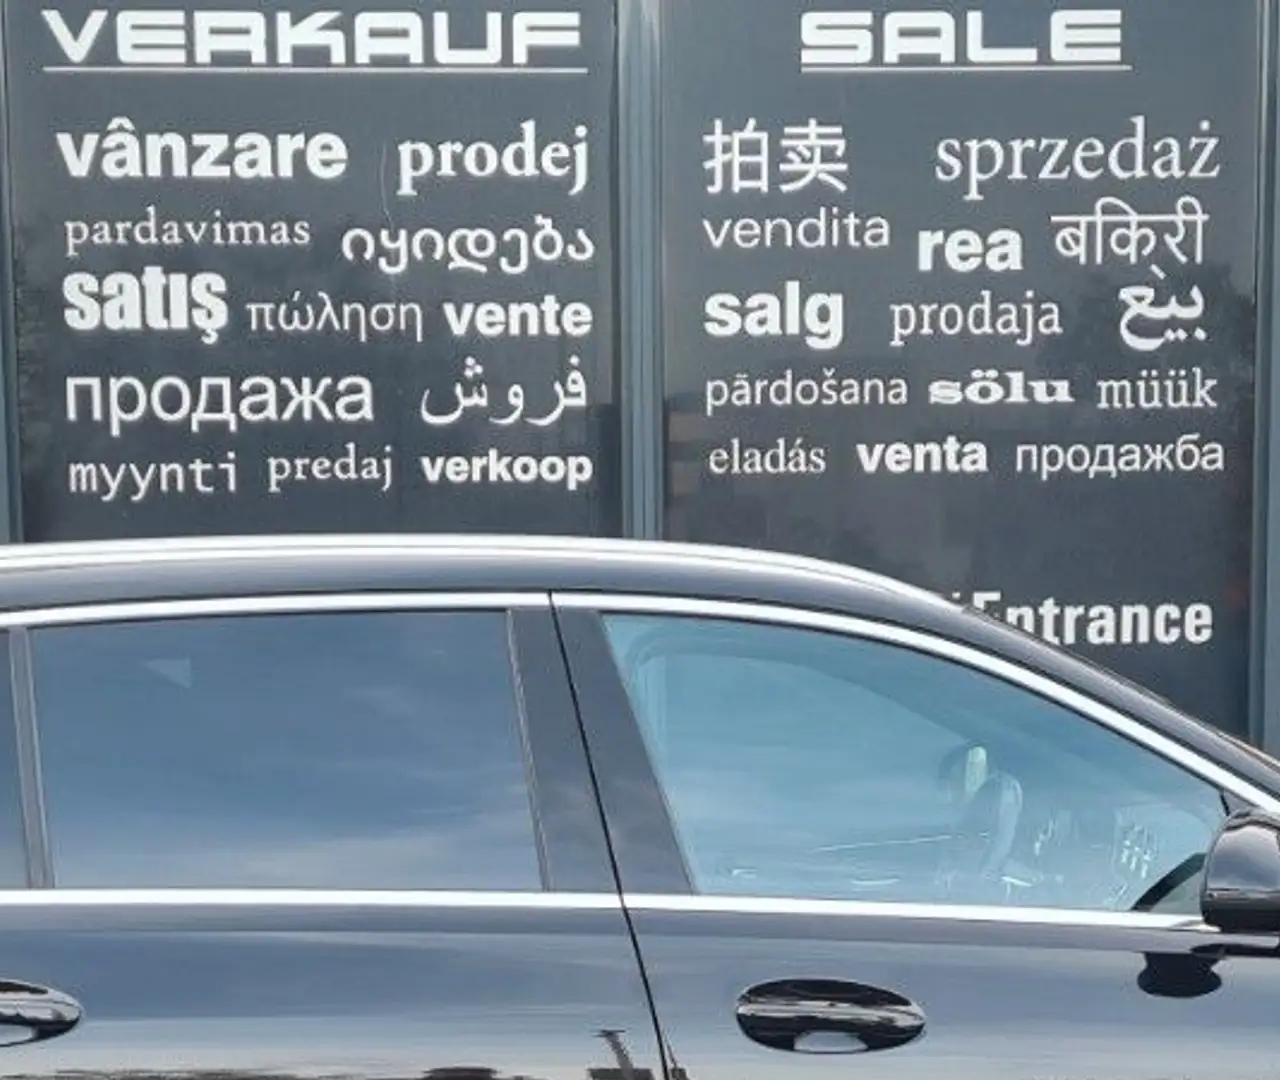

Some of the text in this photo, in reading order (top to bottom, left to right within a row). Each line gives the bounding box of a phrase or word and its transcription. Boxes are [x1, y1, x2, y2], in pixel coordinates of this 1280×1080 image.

[42, 10, 580, 64] VERKAUF
[801, 10, 1121, 64] SALE
[56, 117, 588, 196] vânzare prodej
[703, 118, 848, 194] 拍卖
[935, 115, 1220, 201] sprzedaż
[65, 205, 310, 257] pardavimas
[342, 214, 595, 275] იყიდება
[703, 206, 1022, 272] vendita rea
[63, 266, 228, 344] satış
[245, 290, 423, 343] πώληση
[443, 295, 593, 336] vente
[704, 280, 1063, 350] salg prodaja
[66, 376, 374, 437] продажа
[421, 355, 587, 426] فروش
[706, 367, 1217, 417] pārdošana sölu müük
[69, 442, 593, 501] myynti predaj verkoop
[709, 436, 987, 474] eladás venta
[1016, 433, 1224, 481] продажба
